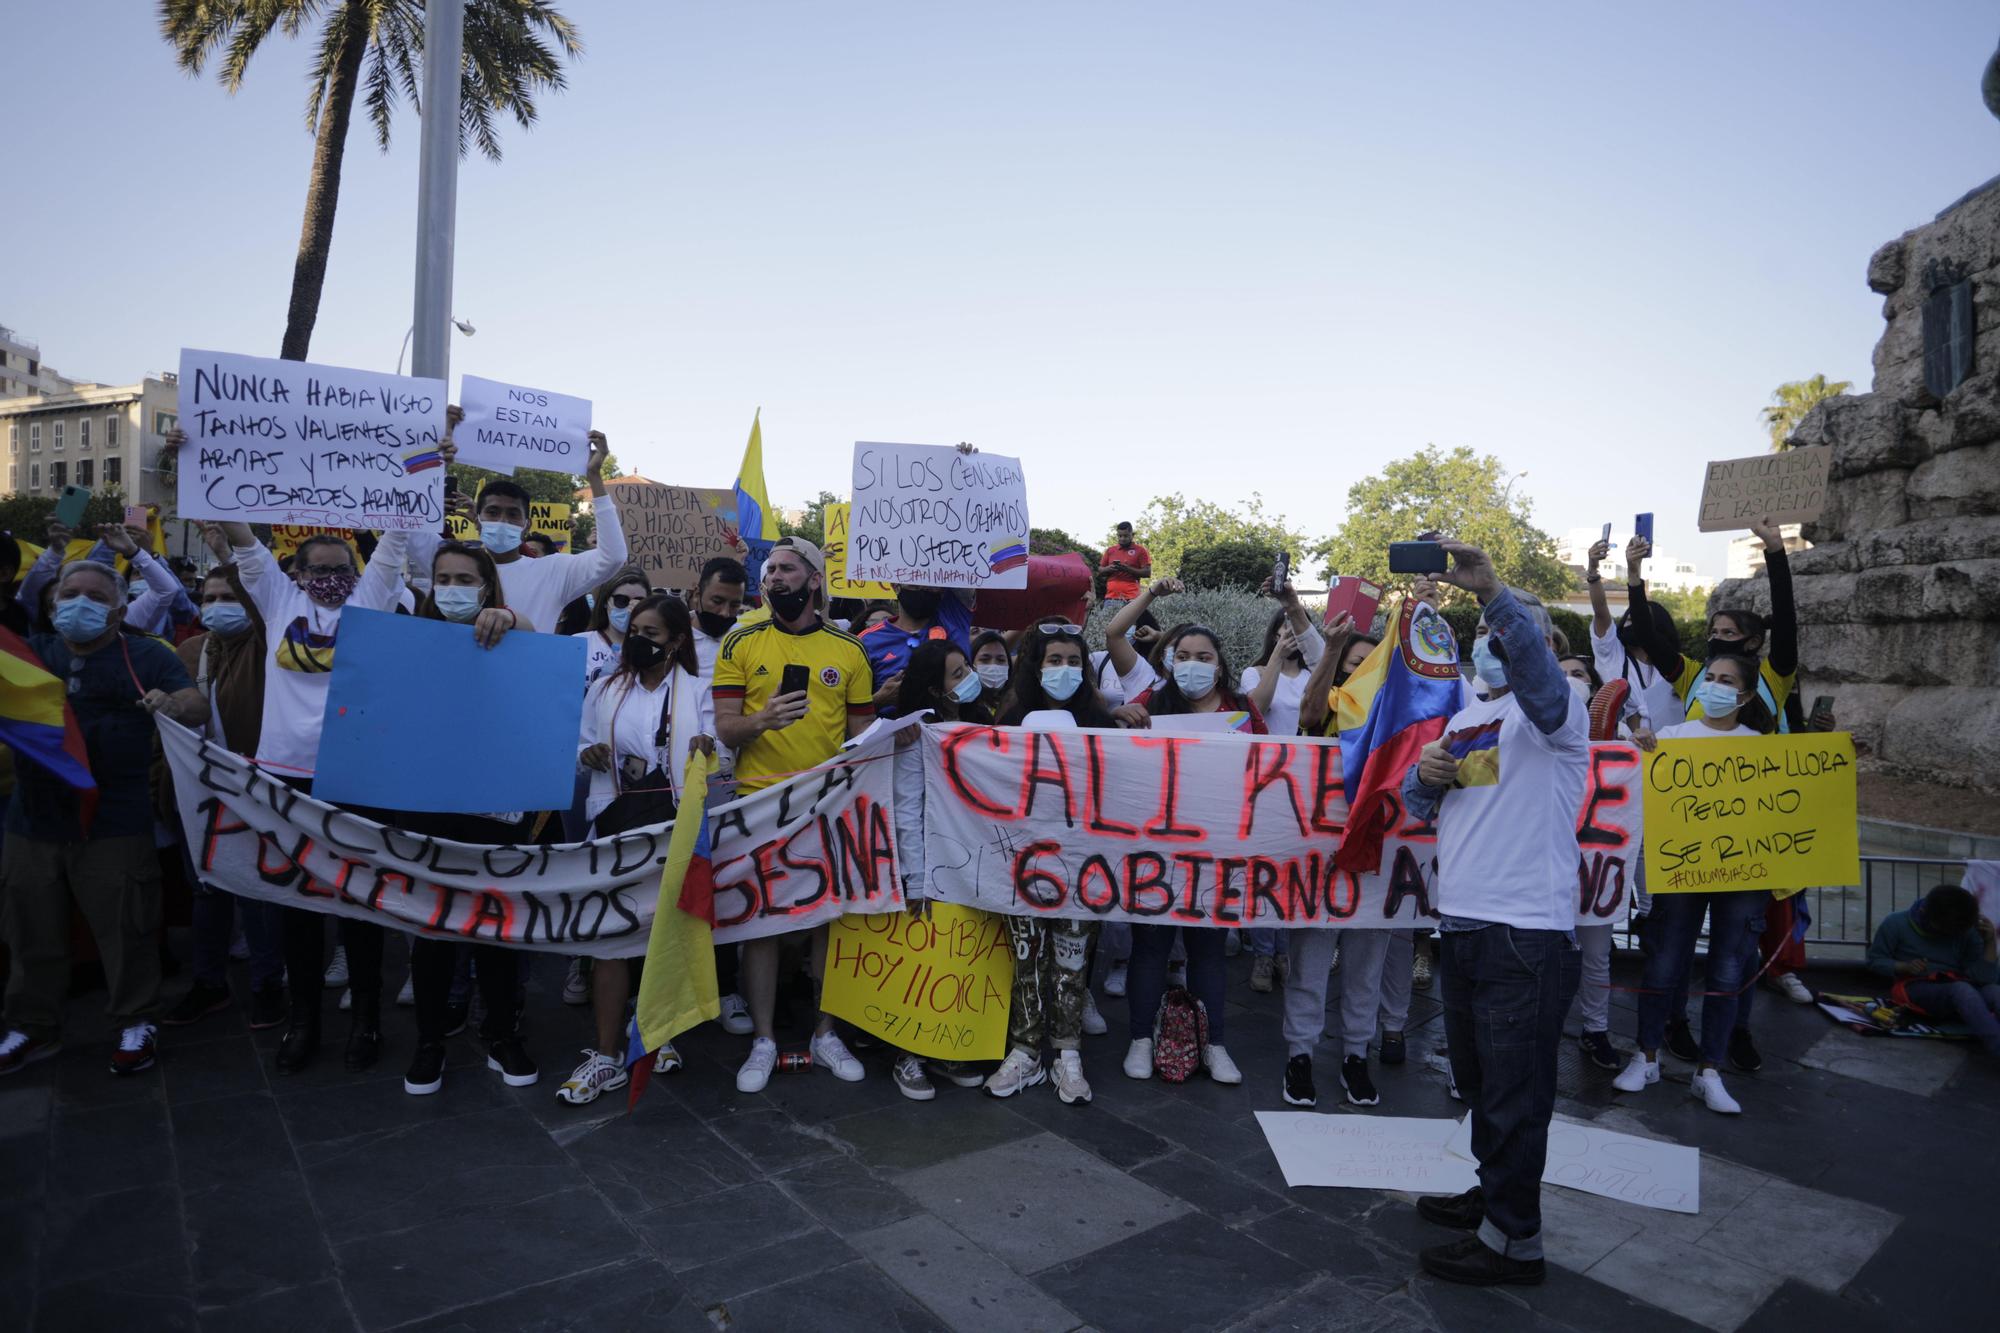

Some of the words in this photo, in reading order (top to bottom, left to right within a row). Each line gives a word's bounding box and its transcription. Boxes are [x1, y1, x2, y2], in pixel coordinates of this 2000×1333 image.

[194, 363, 290, 404] NUNCA
[307, 378, 375, 409] HABIA
[380, 387, 433, 415] VISTO
[508, 389, 548, 407] NOS
[194, 410, 286, 440] TANTOS
[295, 415, 401, 448] VALIENTES
[406, 425, 438, 446] SIN
[495, 407, 558, 429] ESTAN
[477, 428, 571, 455] MATANDO
[199, 448, 283, 475] ARMAS
[300, 452, 315, 488] Y
[321, 451, 403, 477] TANTOS
[854, 450, 884, 490] SI
[896, 455, 944, 492] LOS
[950, 457, 1021, 490] CENSURAN
[1709, 463, 1734, 481] EN
[1740, 452, 1822, 479] COLOMBIA
[614, 485, 702, 513] COLOMBIA
[858, 496, 961, 532] NOSOTROS
[966, 498, 1028, 538] GRITAMOS
[1702, 502, 1725, 521] EL
[1733, 490, 1822, 519] FASCISMO
[645, 511, 696, 536] HIJOS
[703, 515, 727, 537] EN
[626, 554, 662, 571] BIEN
[666, 554, 684, 569] TE
[628, 534, 722, 554] EXTRANJERO
[855, 534, 890, 562] POR
[900, 535, 991, 579] USTEDES
[940, 725, 1208, 841] CALI
[1650, 752, 1781, 793] COLOMBIA
[1785, 749, 1849, 778] LLORA
[1671, 794, 1746, 823] PERO
[1758, 789, 1801, 814] NO
[712, 793, 900, 928] SESINA
[1659, 838, 1703, 872] SE
[1711, 829, 1817, 863] RINDE
[833, 938, 904, 992] HOY
